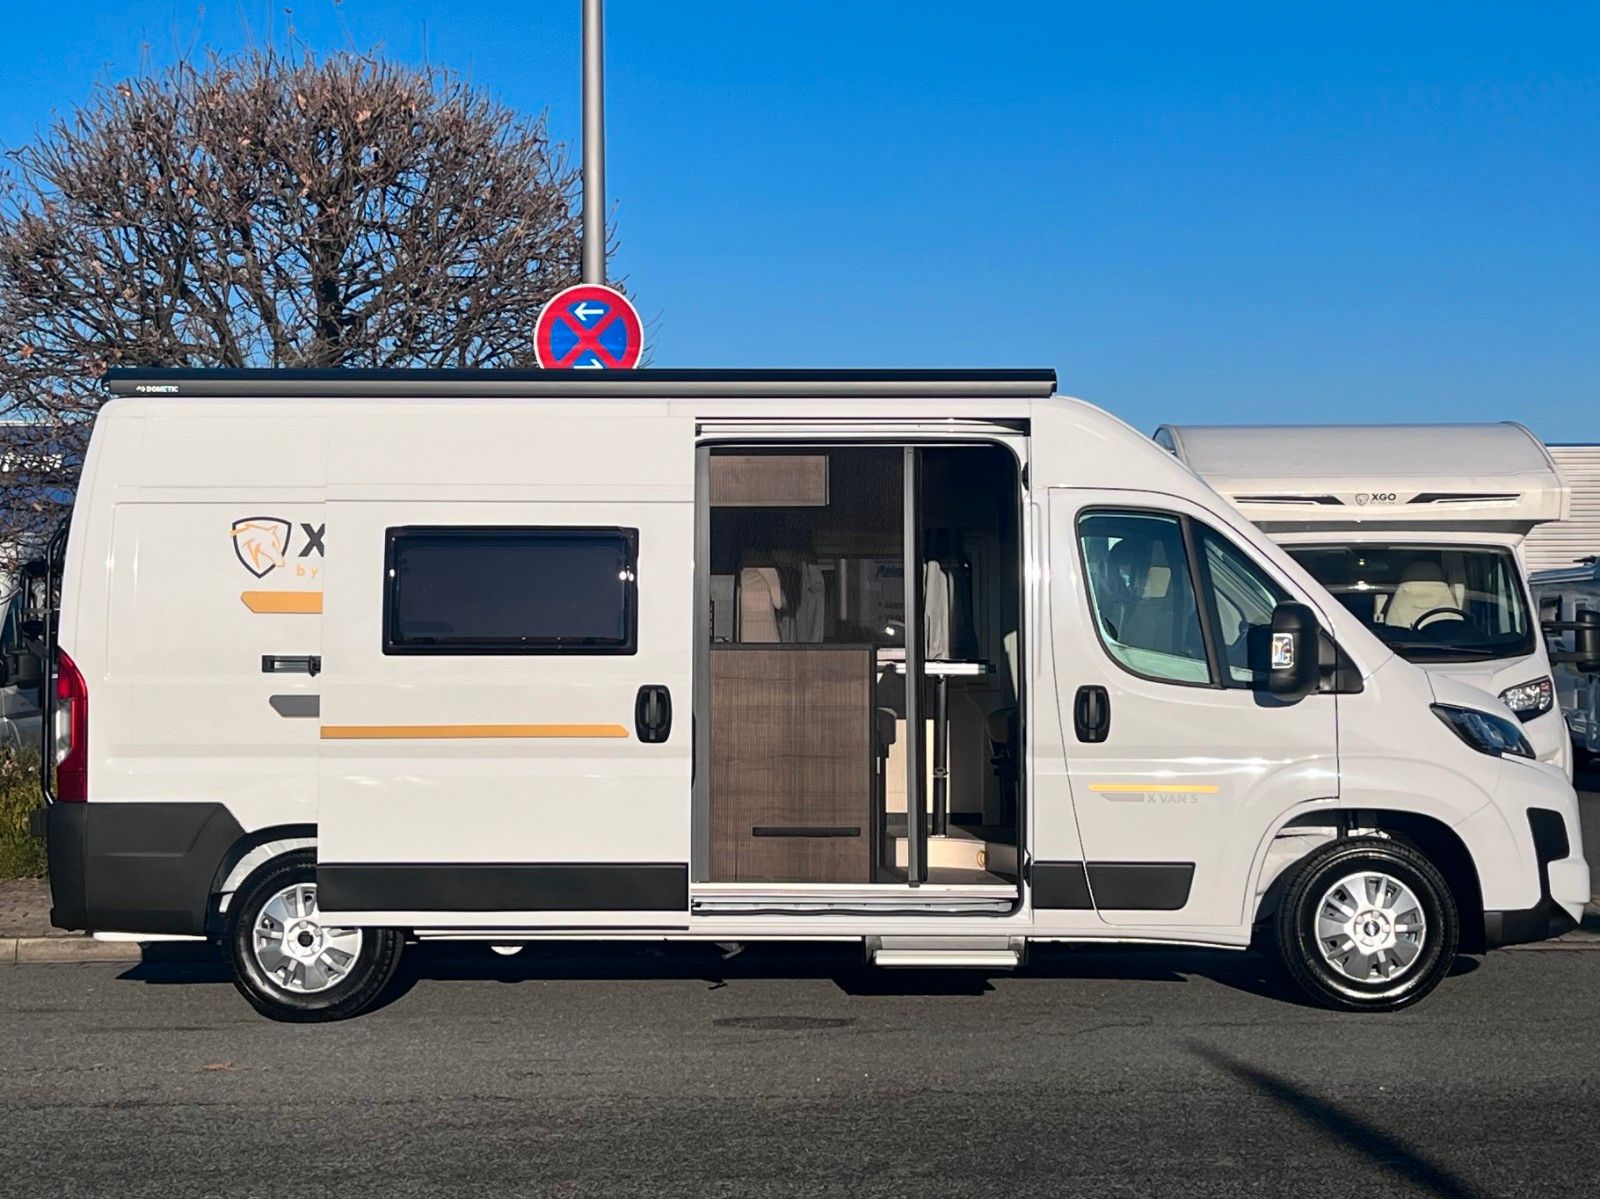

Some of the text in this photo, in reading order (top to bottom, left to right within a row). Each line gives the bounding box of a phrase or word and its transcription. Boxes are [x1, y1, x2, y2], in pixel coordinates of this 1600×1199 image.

[146, 385, 179, 393] DOMETIC
[1371, 493, 1396, 501] XGO
[1146, 793, 1156, 804] X
[1160, 793, 1186, 804] VAN
